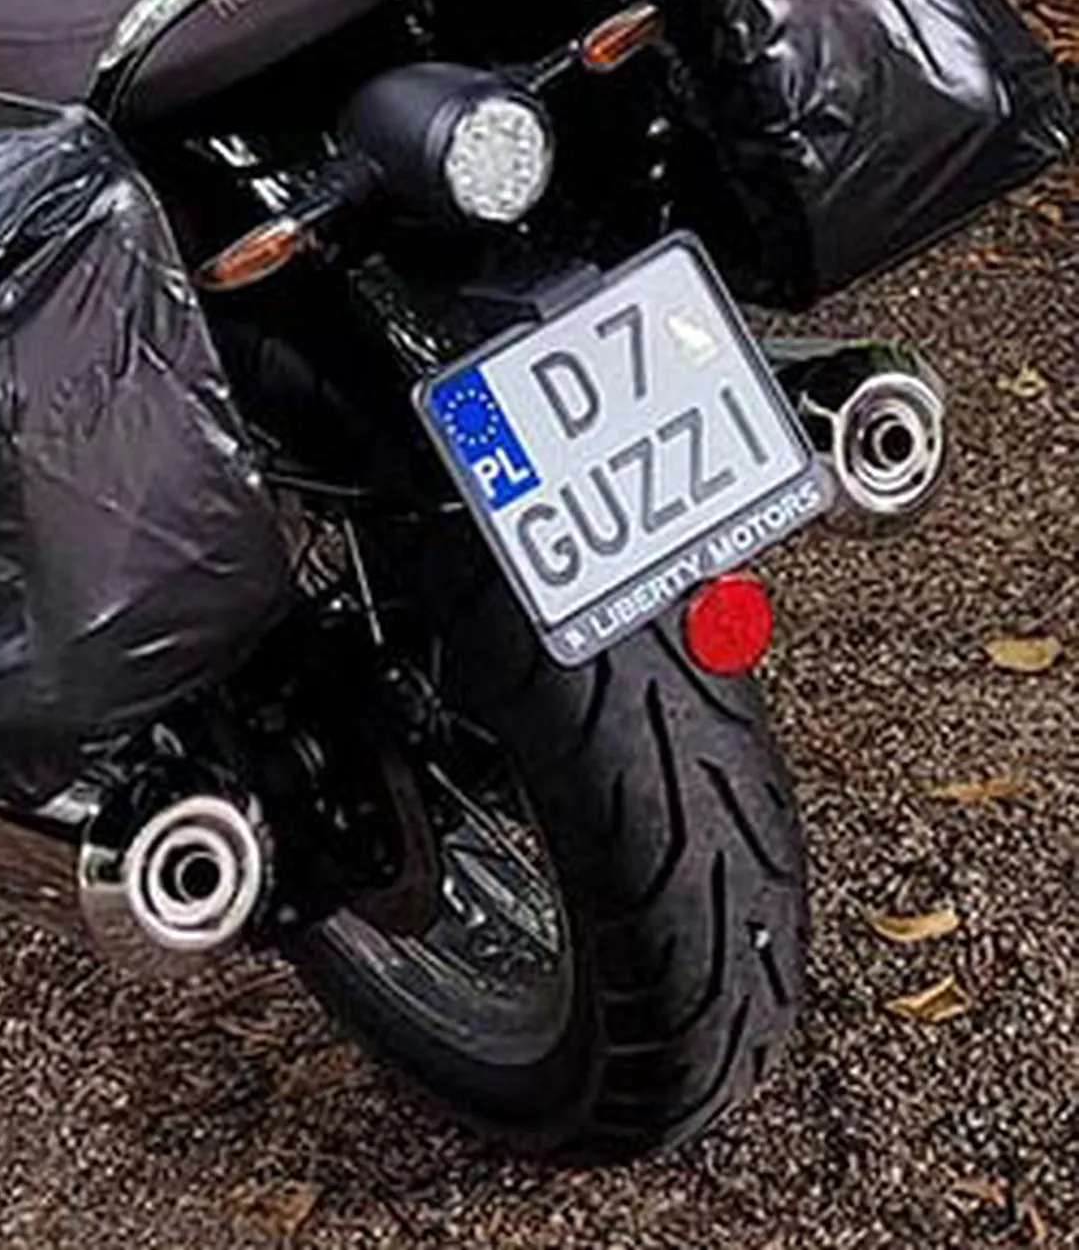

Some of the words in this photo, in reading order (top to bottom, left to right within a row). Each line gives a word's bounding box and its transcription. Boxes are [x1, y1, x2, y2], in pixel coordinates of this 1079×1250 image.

[472, 447, 530, 499] PL
[518, 387, 769, 588] GUZZI
[589, 552, 704, 638] LIBERTY
[707, 480, 821, 557] MOTORS
